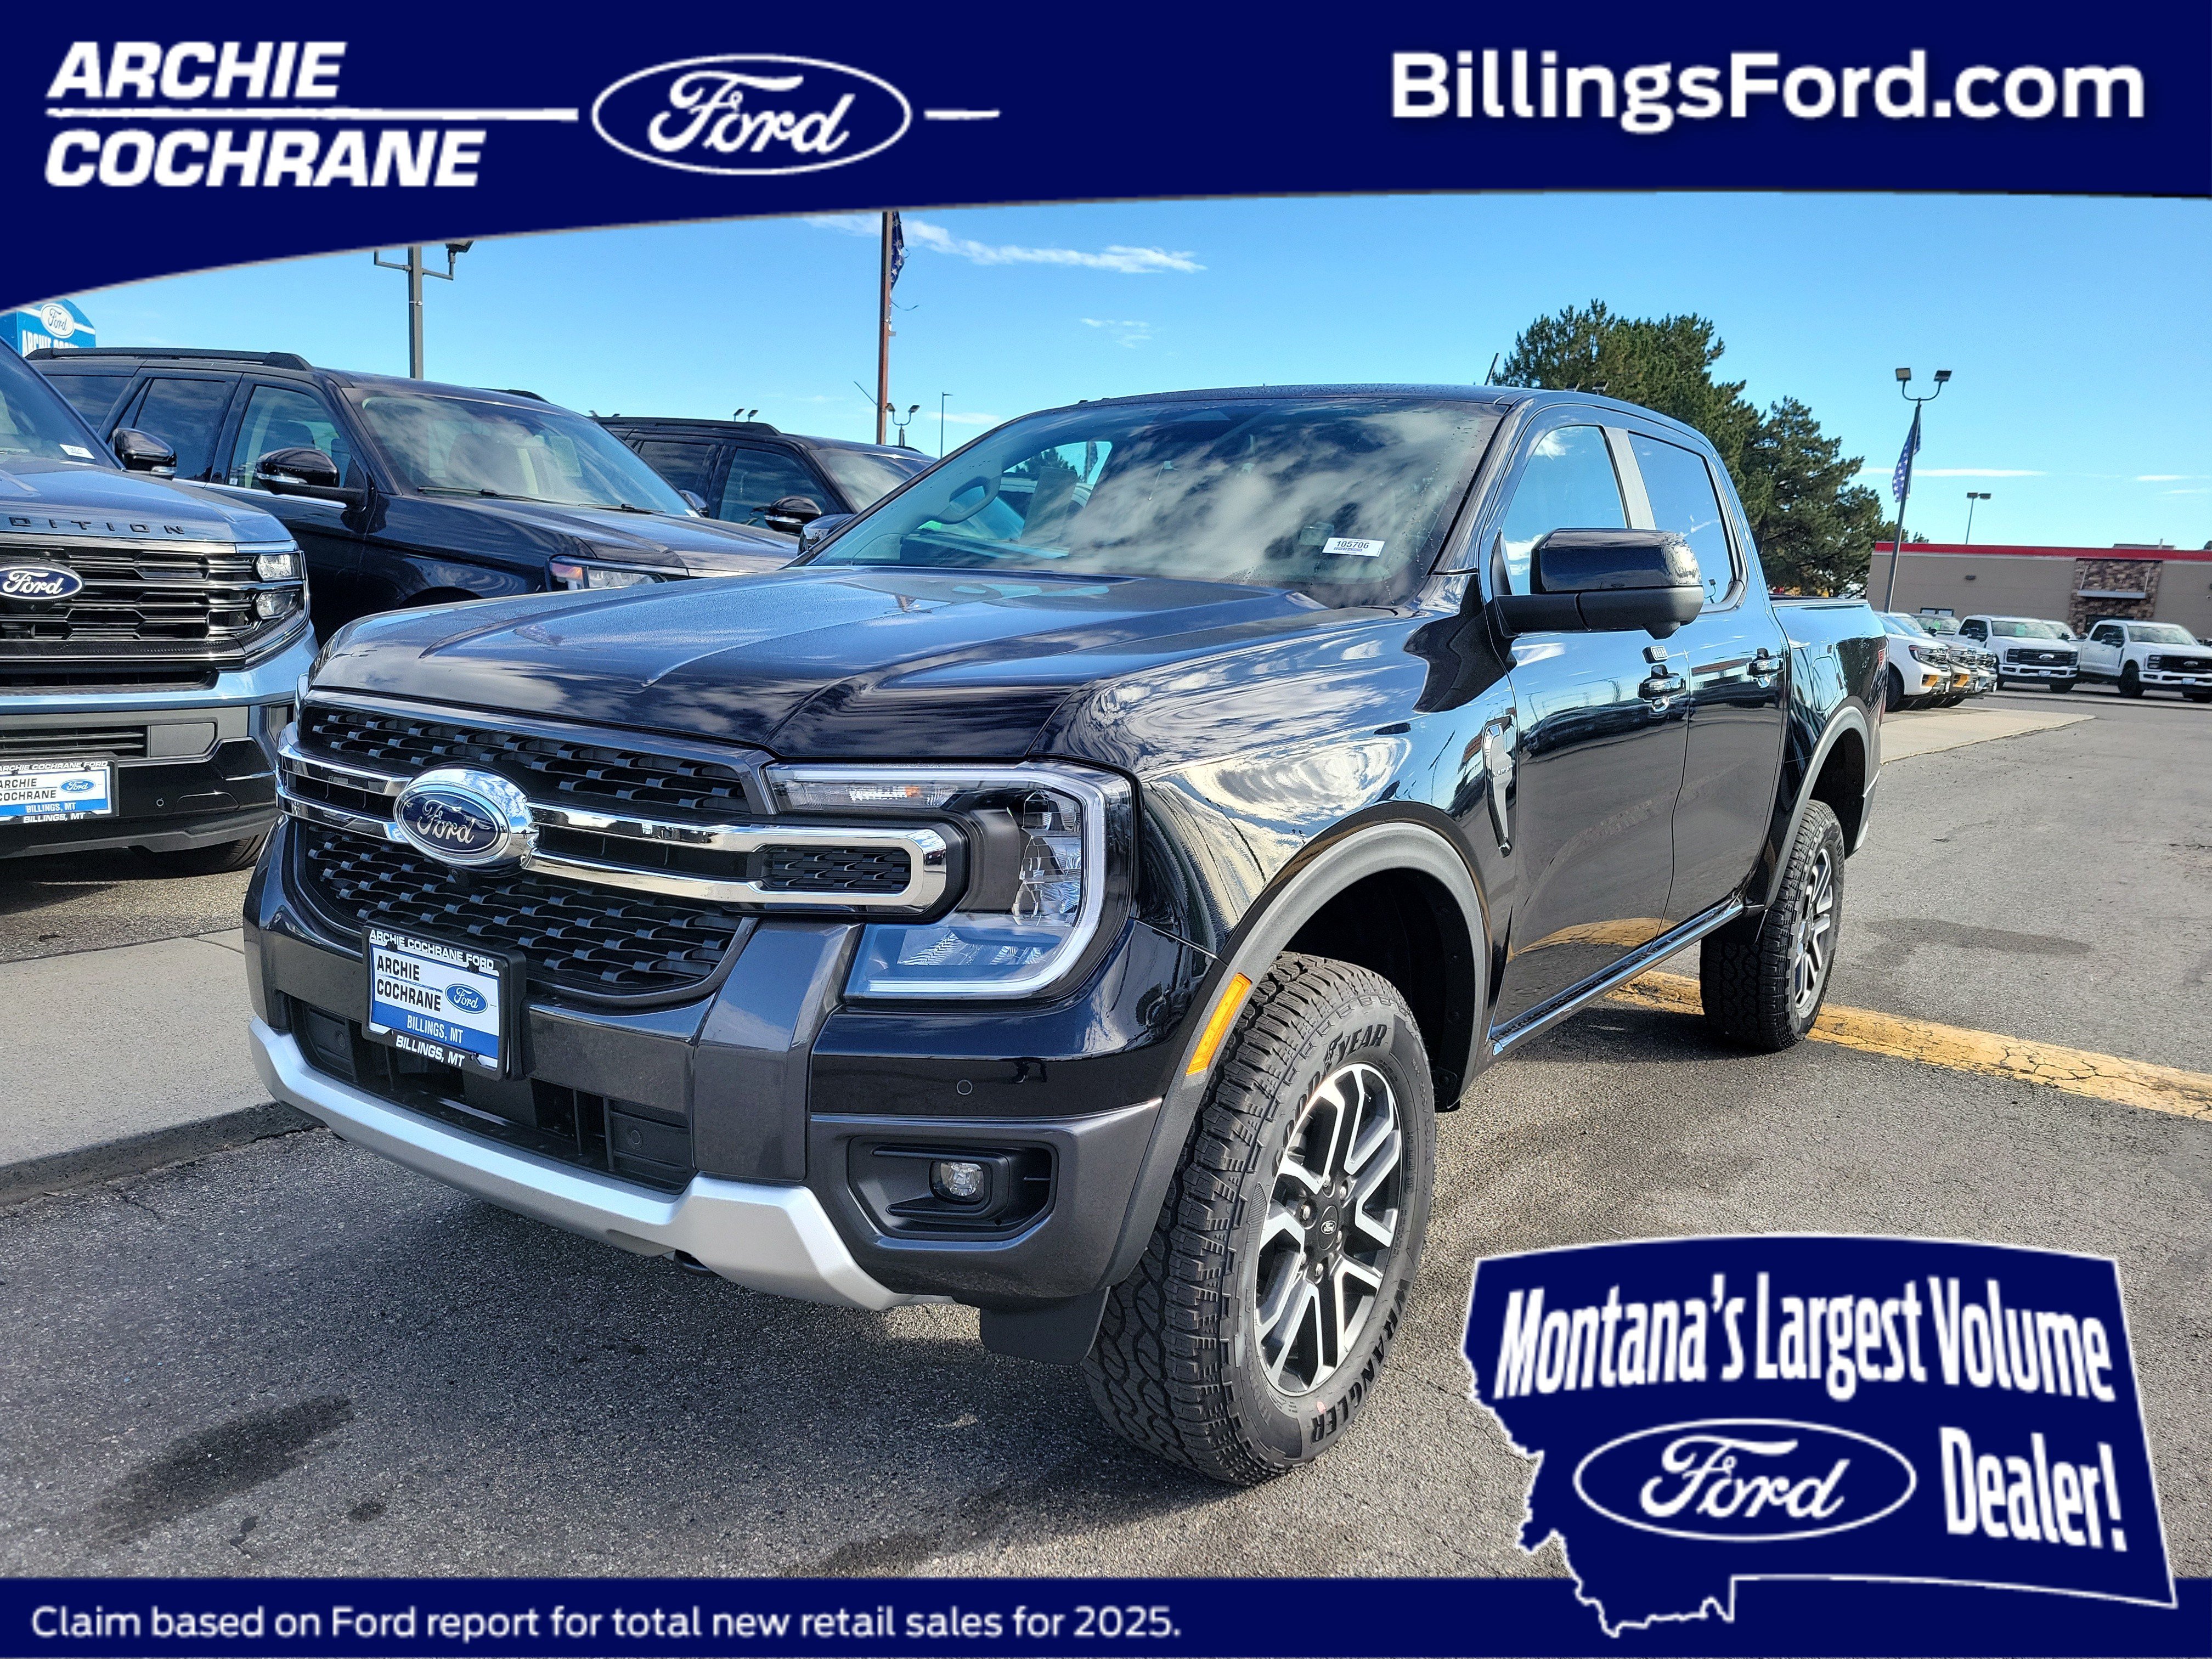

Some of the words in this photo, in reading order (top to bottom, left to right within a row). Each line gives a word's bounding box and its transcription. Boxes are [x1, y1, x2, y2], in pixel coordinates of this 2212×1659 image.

[48, 308, 67, 331] Ford
[3, 571, 64, 594] Ford
[32, 761, 82, 771] COCHRANE
[67, 781, 88, 791] Ford
[23, 814, 68, 823] BILLINGS,
[26, 803, 63, 813] BILLINGS,
[64, 802, 76, 810] MT
[417, 799, 476, 844] Ford
[369, 929, 405, 947] ARCHIE
[408, 939, 463, 962] COCHRANE
[466, 954, 494, 970] FORD
[377, 955, 420, 981] ARCHIE
[377, 979, 441, 1012] COCHRANE
[454, 988, 479, 1009] Ford
[407, 1014, 447, 1042] BILLINGS,
[450, 1027, 464, 1043] MT
[396, 1035, 445, 1063] BILLINGS,
[448, 1051, 465, 1067] MT
[1311, 1279, 1412, 1444] WRANGLER
